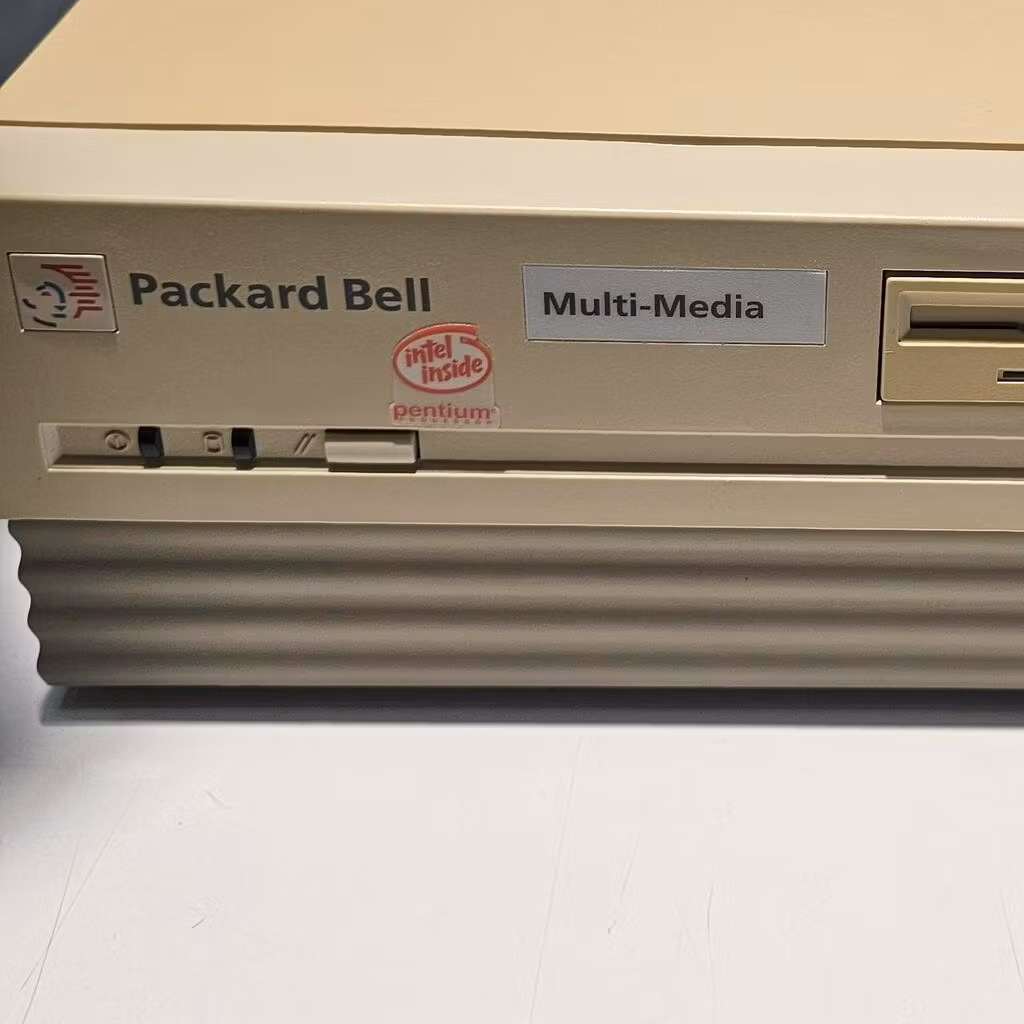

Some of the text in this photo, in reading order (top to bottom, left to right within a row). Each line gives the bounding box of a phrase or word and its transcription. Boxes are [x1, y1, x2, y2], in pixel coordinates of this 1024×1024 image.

[130, 273, 431, 312] Packard Bell
[543, 291, 764, 319] Multi-Media
[405, 335, 452, 367] intel
[422, 354, 483, 384] inside
[393, 403, 491, 421] pentium
